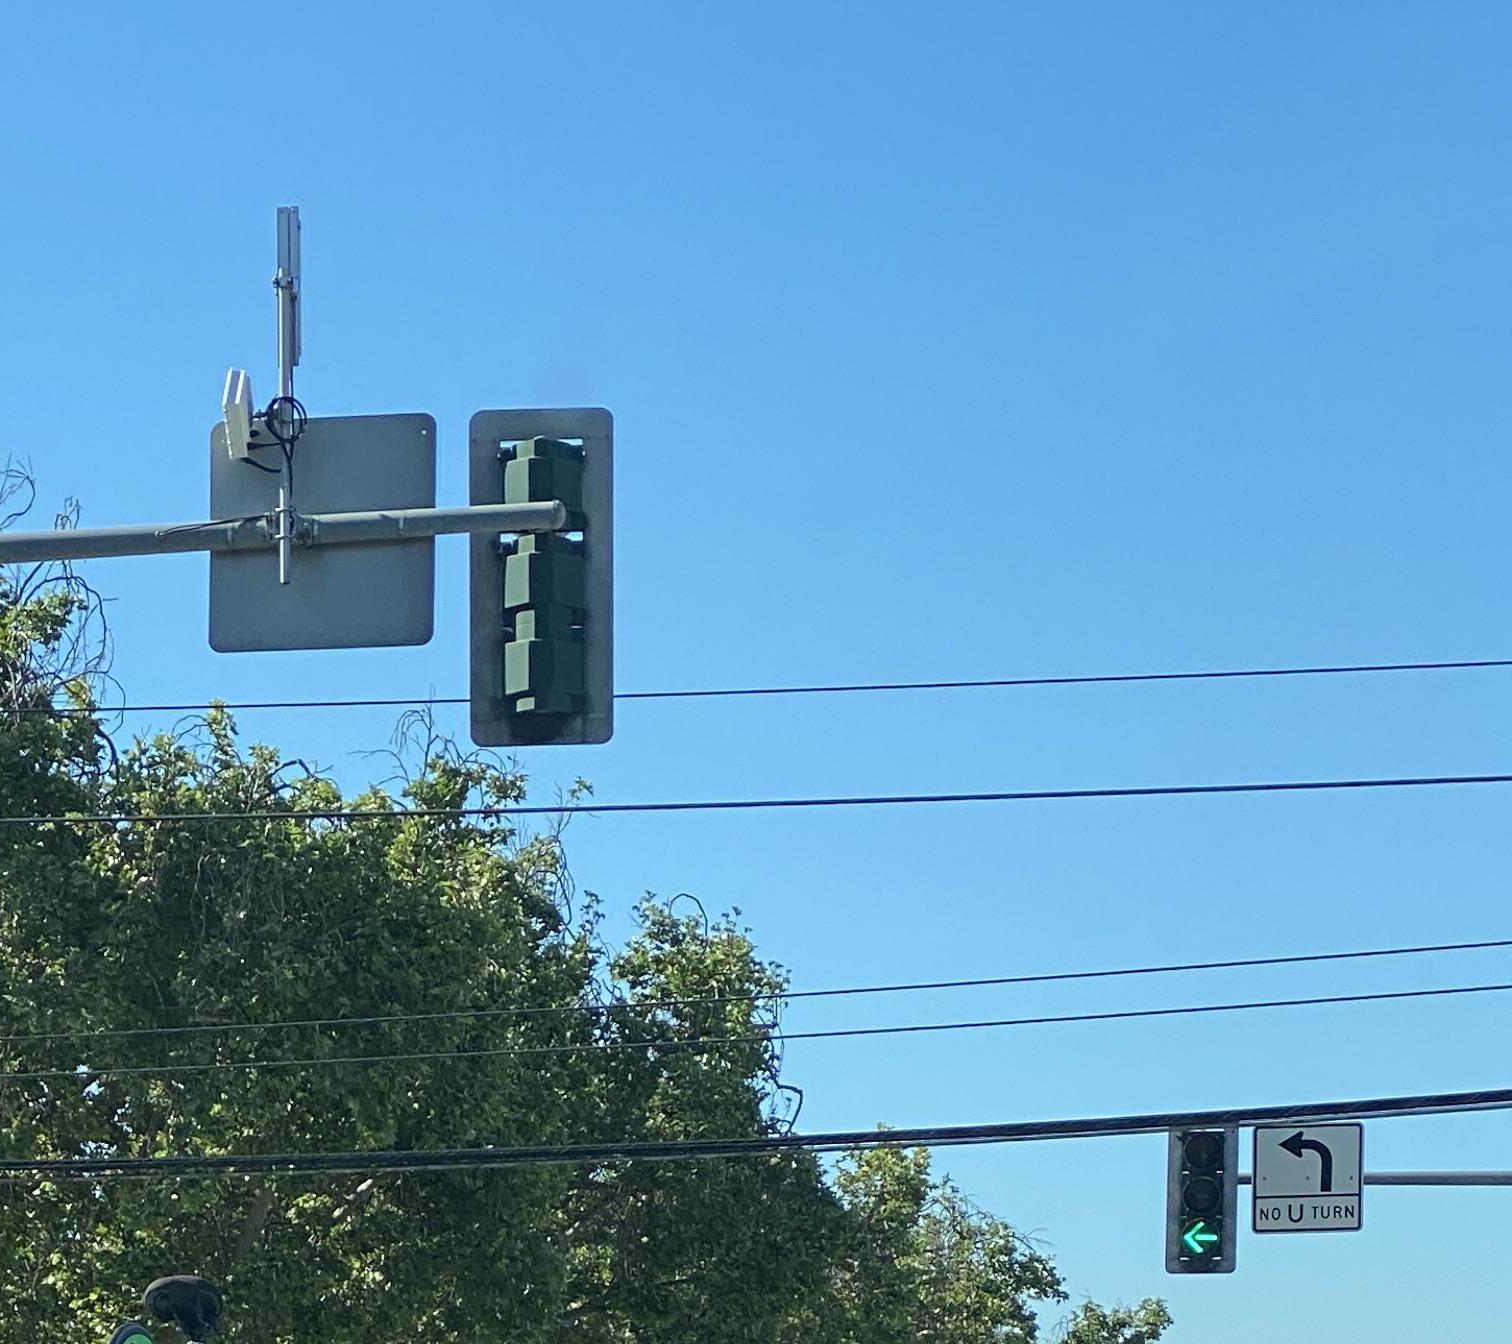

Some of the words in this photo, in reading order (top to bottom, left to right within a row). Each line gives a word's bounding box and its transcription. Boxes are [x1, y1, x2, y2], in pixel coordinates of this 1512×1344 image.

[1260, 1206, 1281, 1221] NO
[1288, 1204, 1304, 1223] U
[1312, 1205, 1355, 1220] TURN
